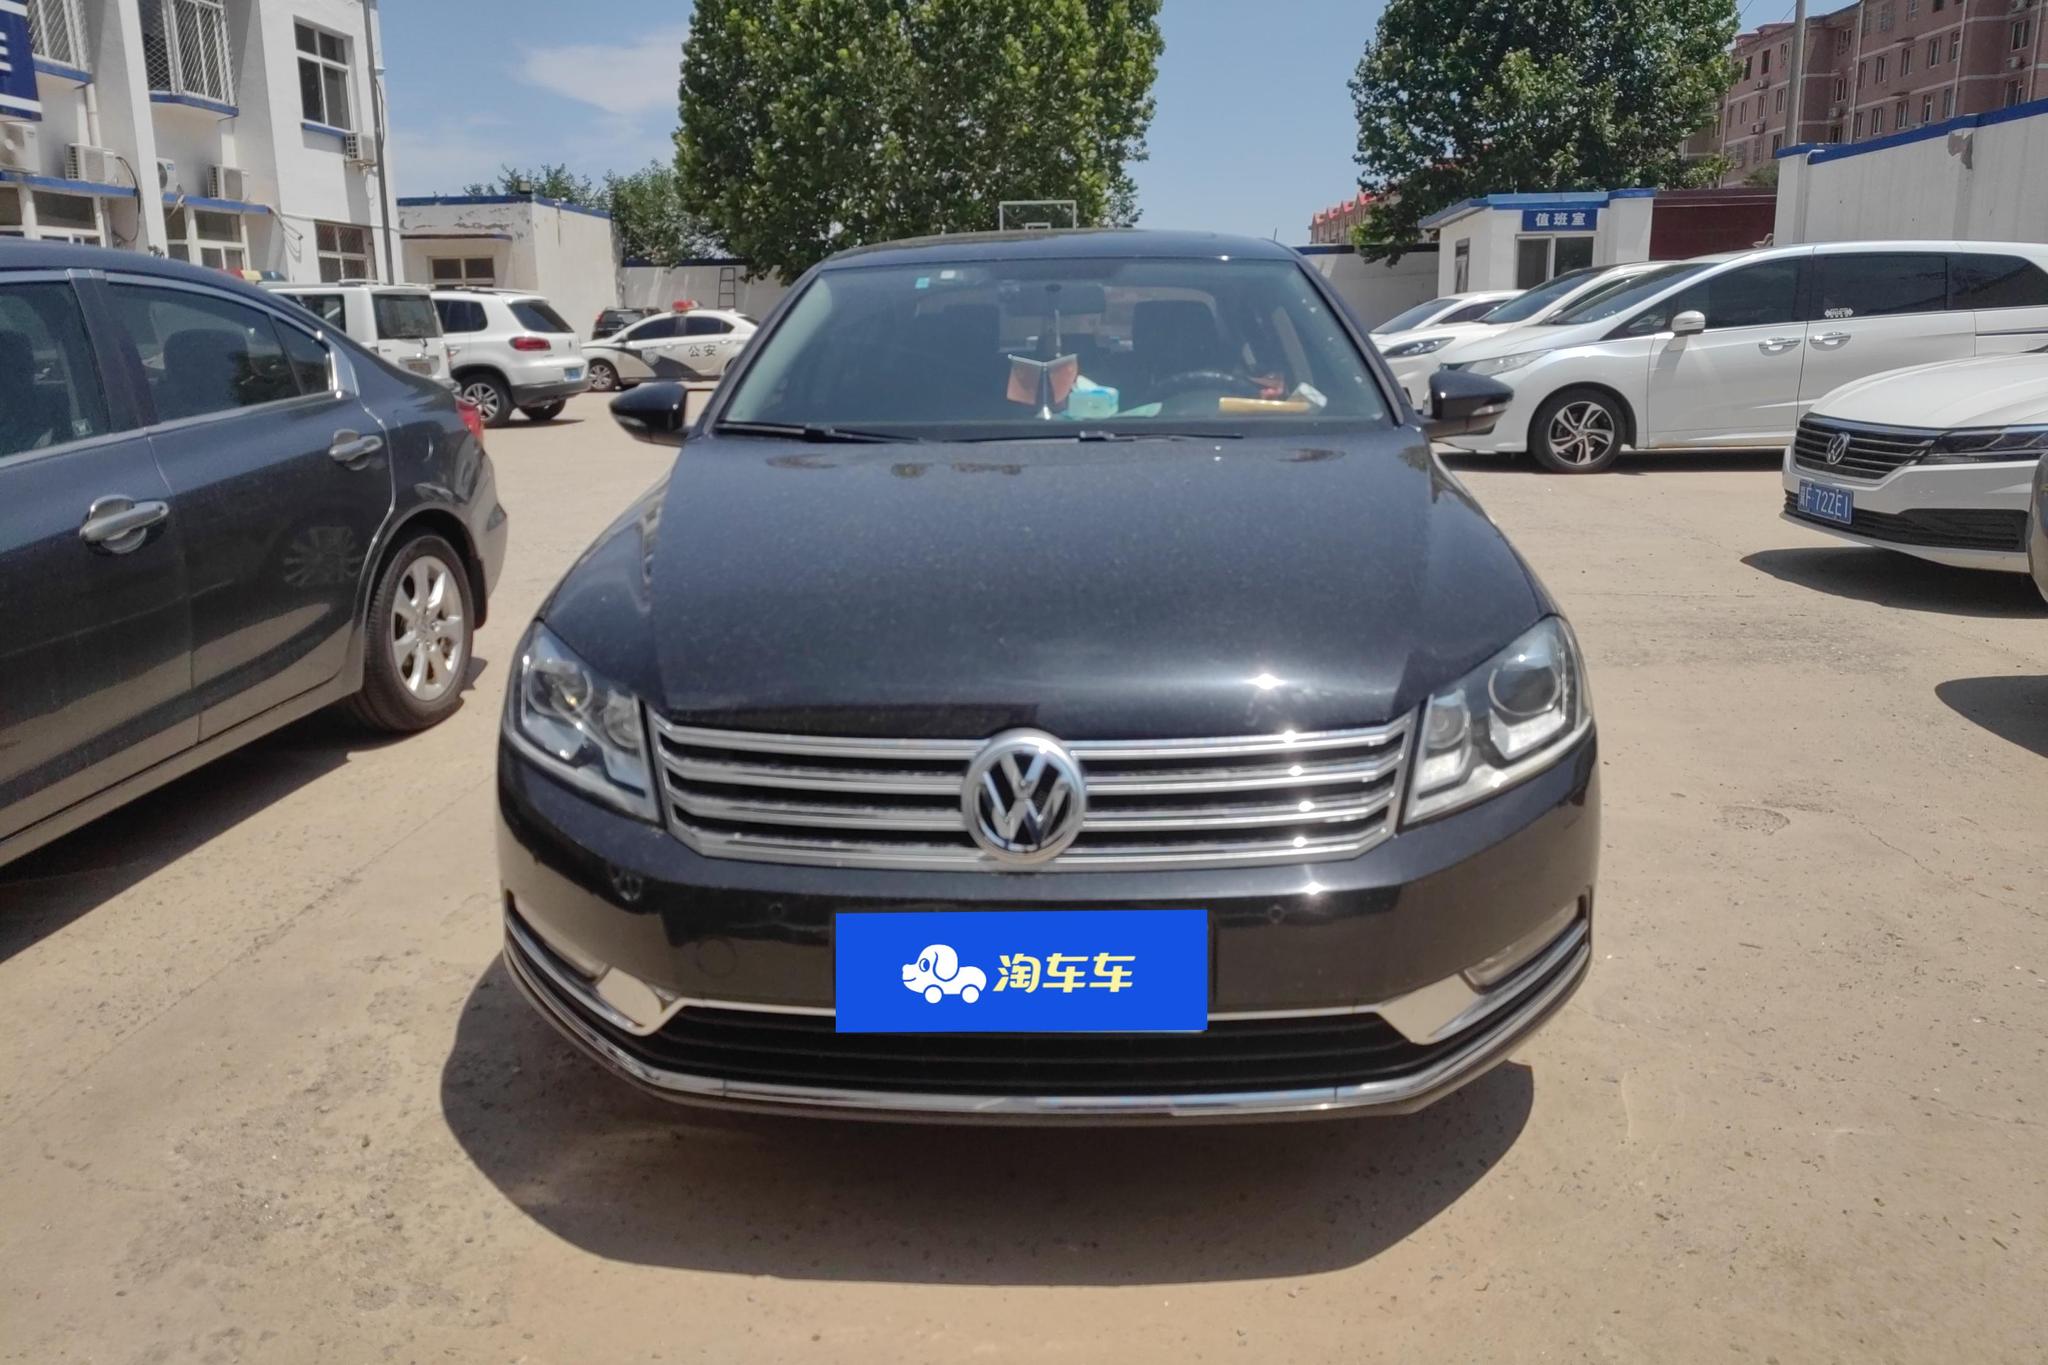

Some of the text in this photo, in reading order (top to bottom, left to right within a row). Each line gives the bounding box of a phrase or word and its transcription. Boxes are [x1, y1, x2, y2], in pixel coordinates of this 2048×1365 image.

[1535, 211, 1586, 226] 值班室
[688, 344, 717, 357] 公安
